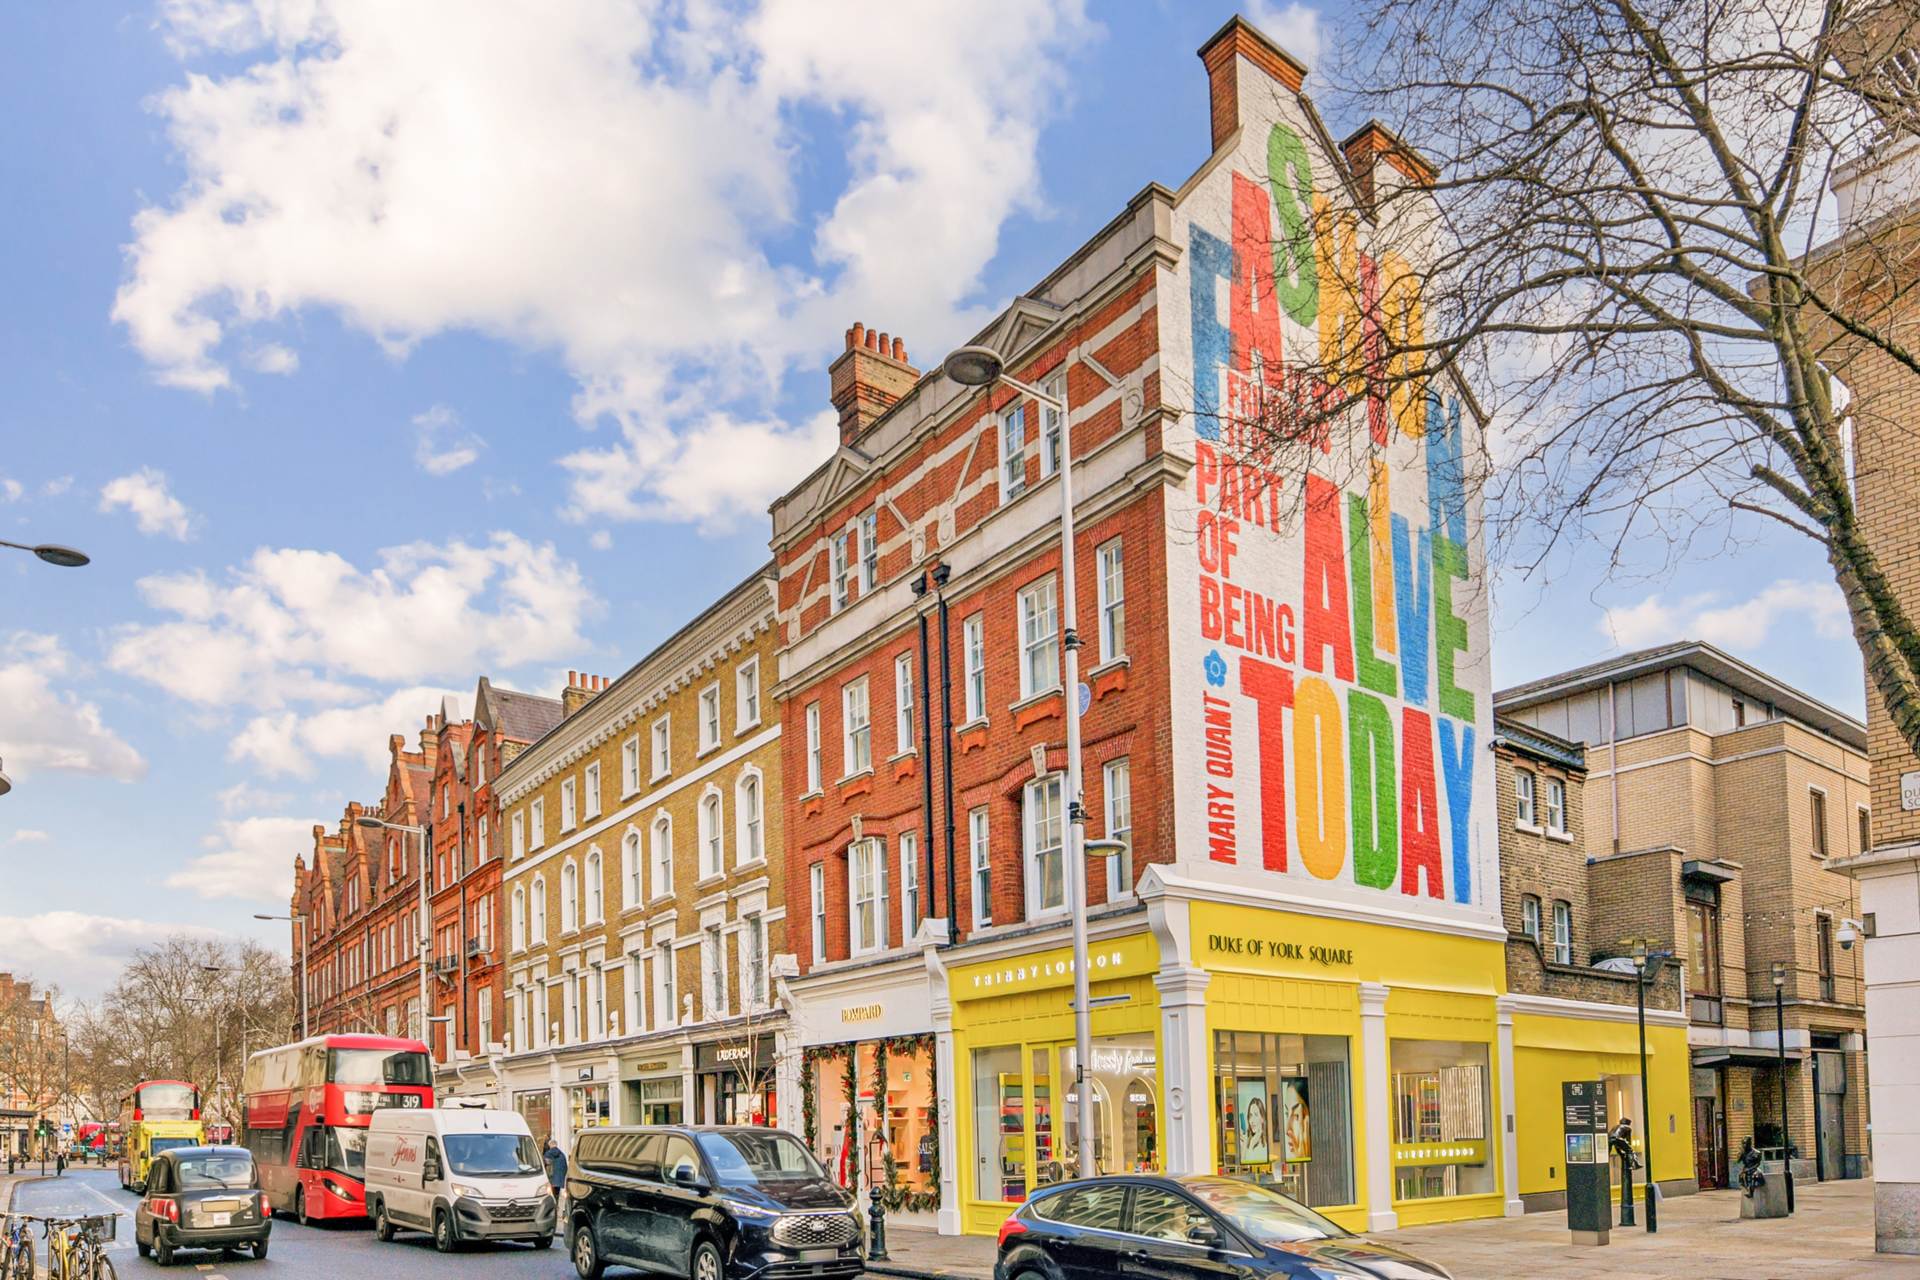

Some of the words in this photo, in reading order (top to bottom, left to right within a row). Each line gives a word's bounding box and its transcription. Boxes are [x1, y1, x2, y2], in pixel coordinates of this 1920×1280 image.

[1189, 122, 1468, 548] FASHION
[1196, 440, 1283, 534] PART
[1197, 510, 1241, 578] OF
[1200, 574, 1296, 665] BEING
[1303, 458, 1476, 724] ALIVE
[1203, 690, 1233, 778] QUANT
[1207, 782, 1237, 865] MARY
[1239, 655, 1475, 903] TODAY
[1209, 934, 1243, 954] DUKE
[1247, 939, 1263, 956] OF
[1269, 941, 1304, 960] YORK
[1309, 945, 1353, 967] SQUARE
[402, 1095, 420, 1108] 319
